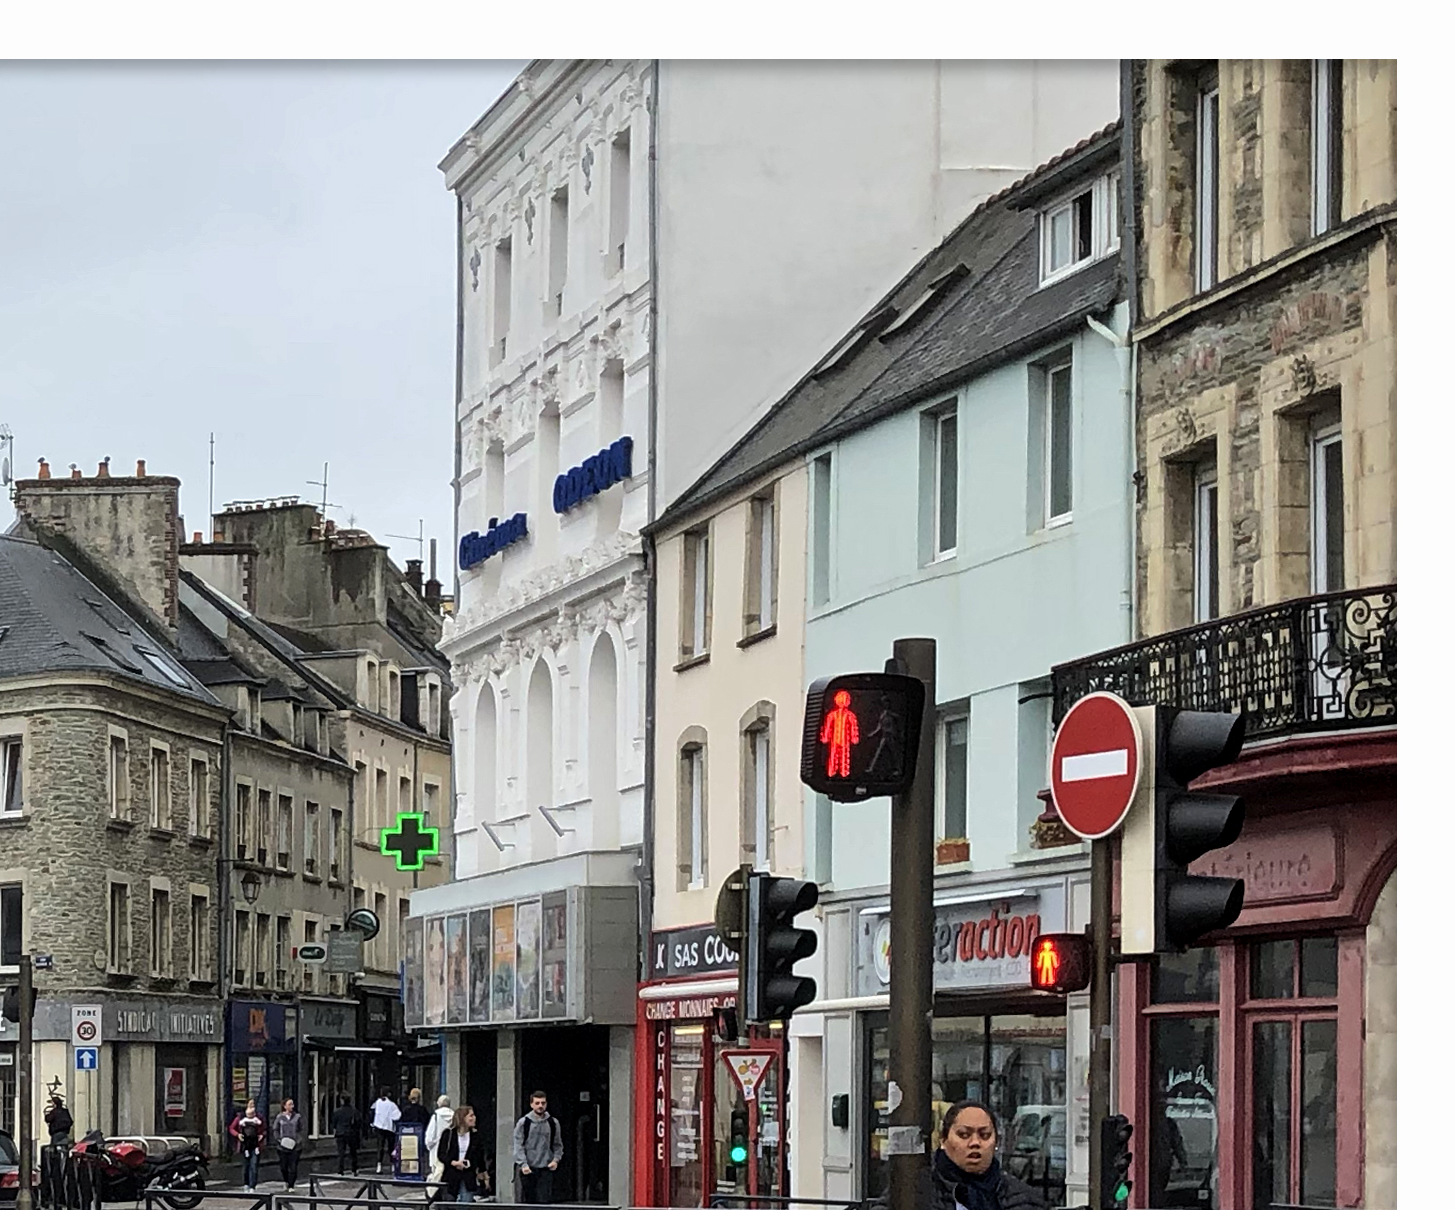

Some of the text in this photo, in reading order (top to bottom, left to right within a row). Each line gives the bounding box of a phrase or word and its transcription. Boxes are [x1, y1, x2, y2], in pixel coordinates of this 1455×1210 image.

[933, 901, 1042, 963] eraction
[674, 942, 700, 969] SAS
[76, 1009, 97, 1017] ZONE
[645, 1000, 677, 1020] CHANGE
[81, 1026, 93, 1036] 30
[657, 1030, 665, 1161] CHANGE
